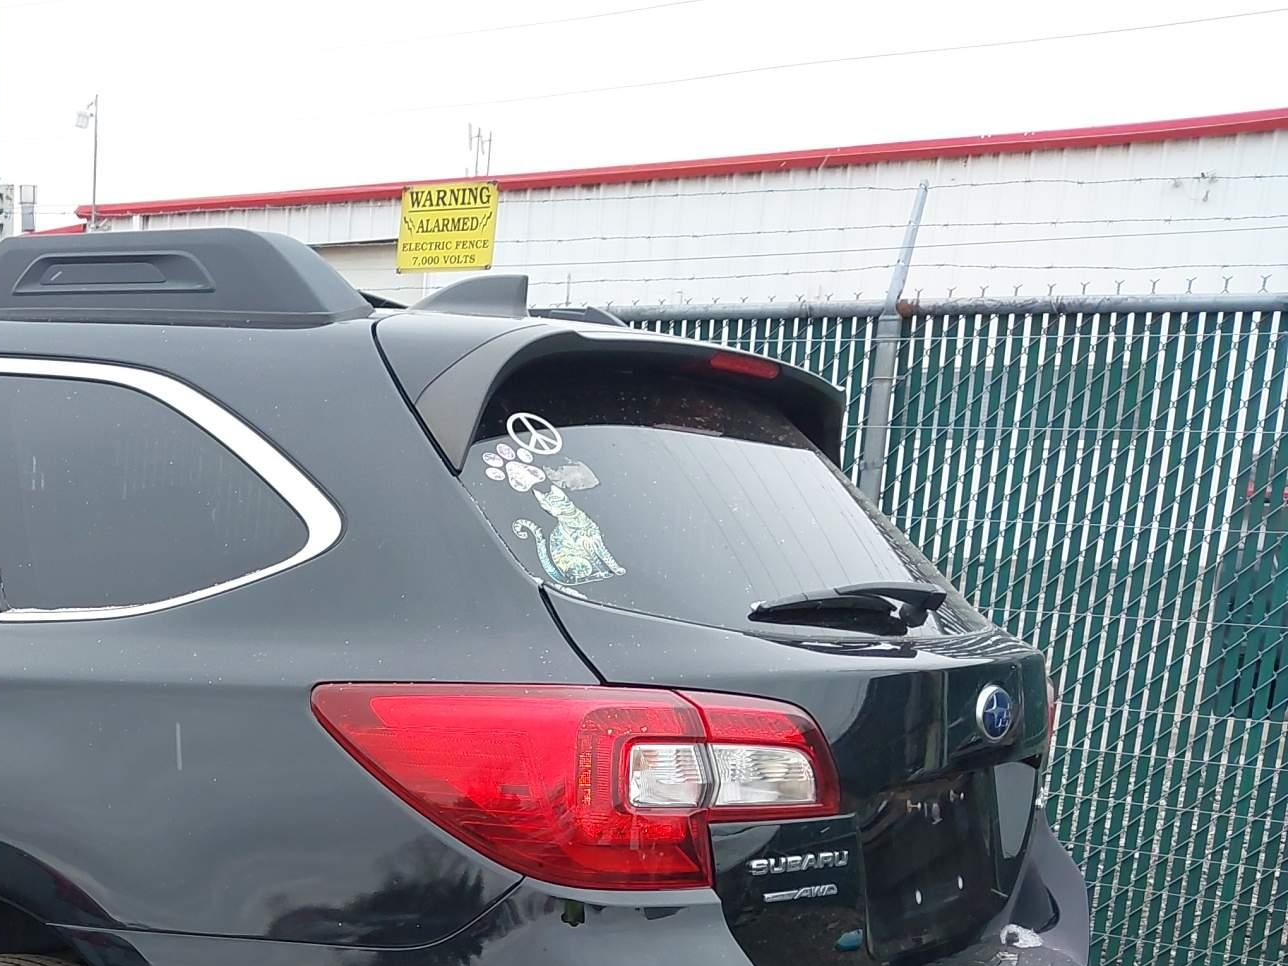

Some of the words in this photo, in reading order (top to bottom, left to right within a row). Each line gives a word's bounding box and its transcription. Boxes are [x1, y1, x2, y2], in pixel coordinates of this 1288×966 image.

[409, 186, 491, 208] WARNING
[416, 216, 479, 234] ALARMED
[402, 241, 452, 252] ELECTRIC
[454, 239, 489, 250] FENCE
[412, 256, 439, 266] 7,000
[443, 254, 476, 265] VOLTS
[747, 850, 849, 876] SUBARU
[793, 884, 838, 900] AWD
